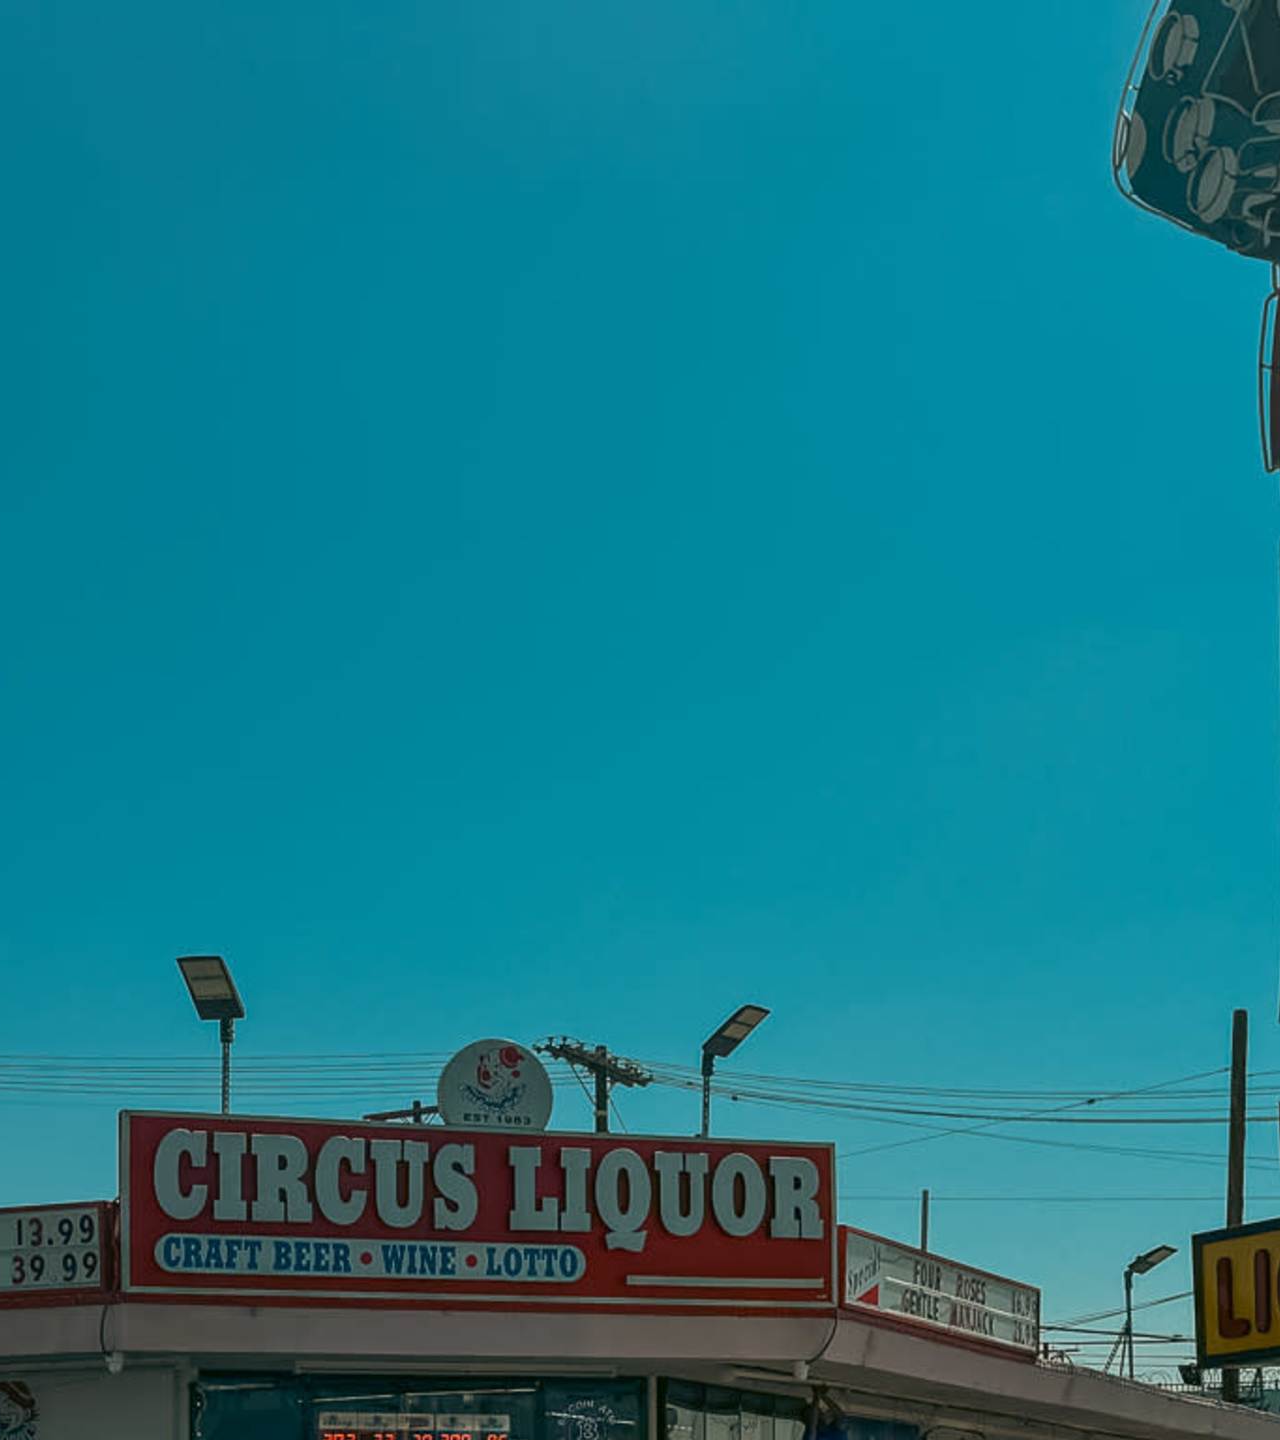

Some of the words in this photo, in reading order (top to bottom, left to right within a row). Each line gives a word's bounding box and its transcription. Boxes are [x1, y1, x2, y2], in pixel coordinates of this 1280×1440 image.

[154, 1127, 478, 1232] CIRCUS
[509, 1146, 823, 1252] LIQUOR
[17, 1214, 95, 1247] 13.99
[162, 1235, 262, 1272] CRAFT
[273, 1238, 352, 1275] BEER
[381, 1242, 457, 1277] WINE
[485, 1245, 579, 1281] LOTTO
